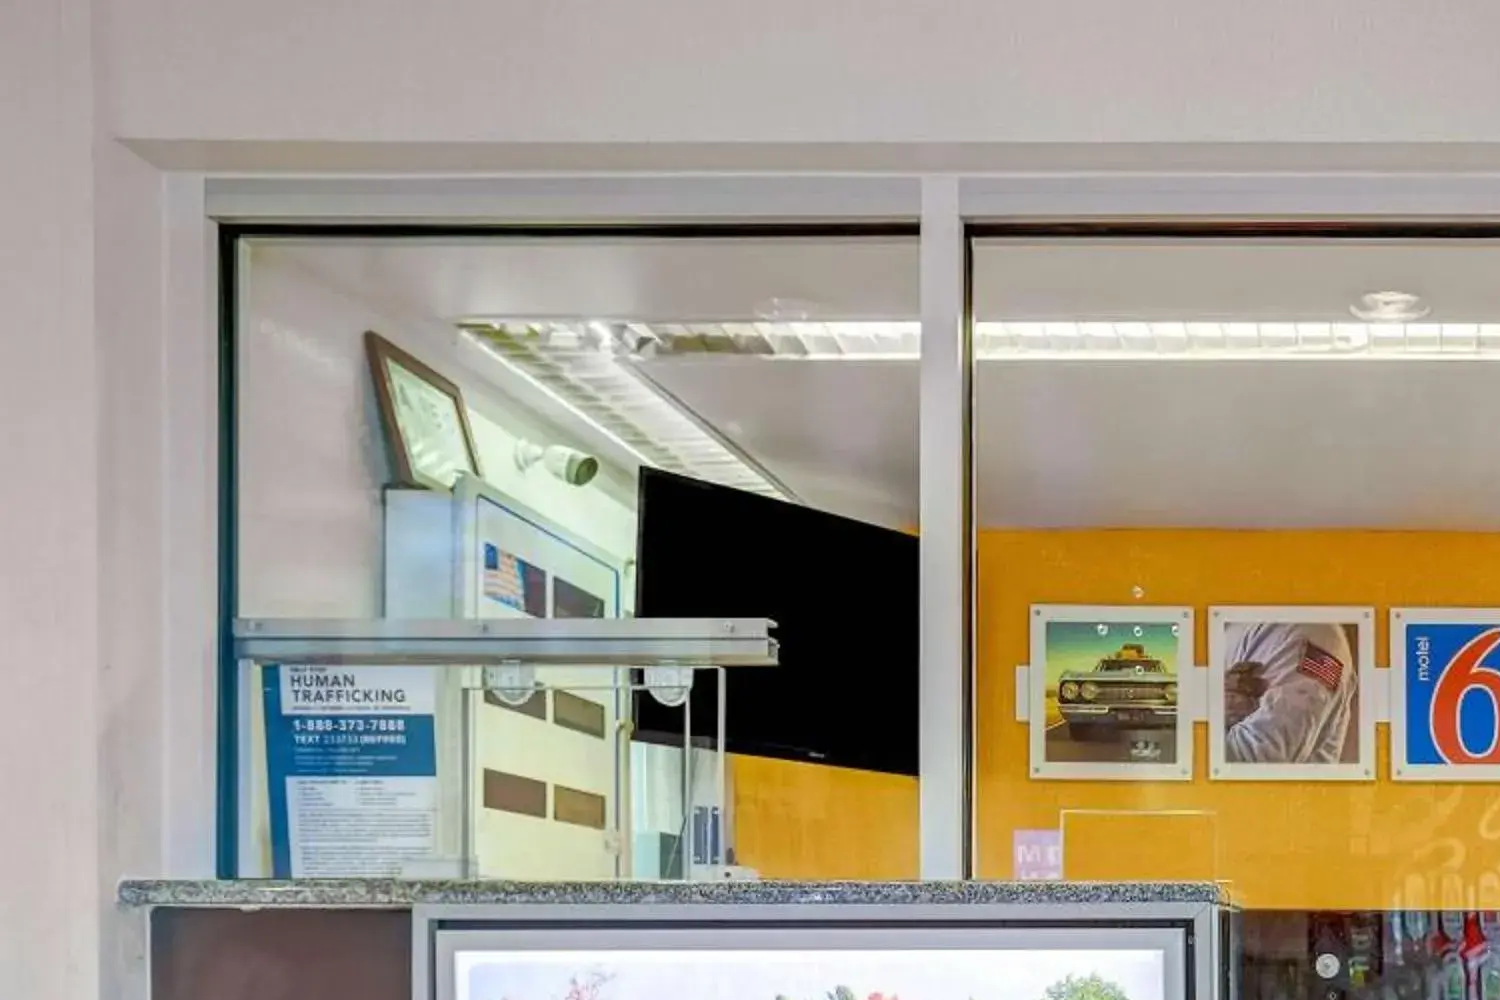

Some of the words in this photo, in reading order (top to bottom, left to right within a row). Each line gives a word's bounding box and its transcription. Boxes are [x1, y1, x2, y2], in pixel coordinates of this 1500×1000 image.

[1415, 637, 1430, 681] motel
[290, 674, 355, 687] HUMAN
[292, 689, 406, 703] TRAFFICKING
